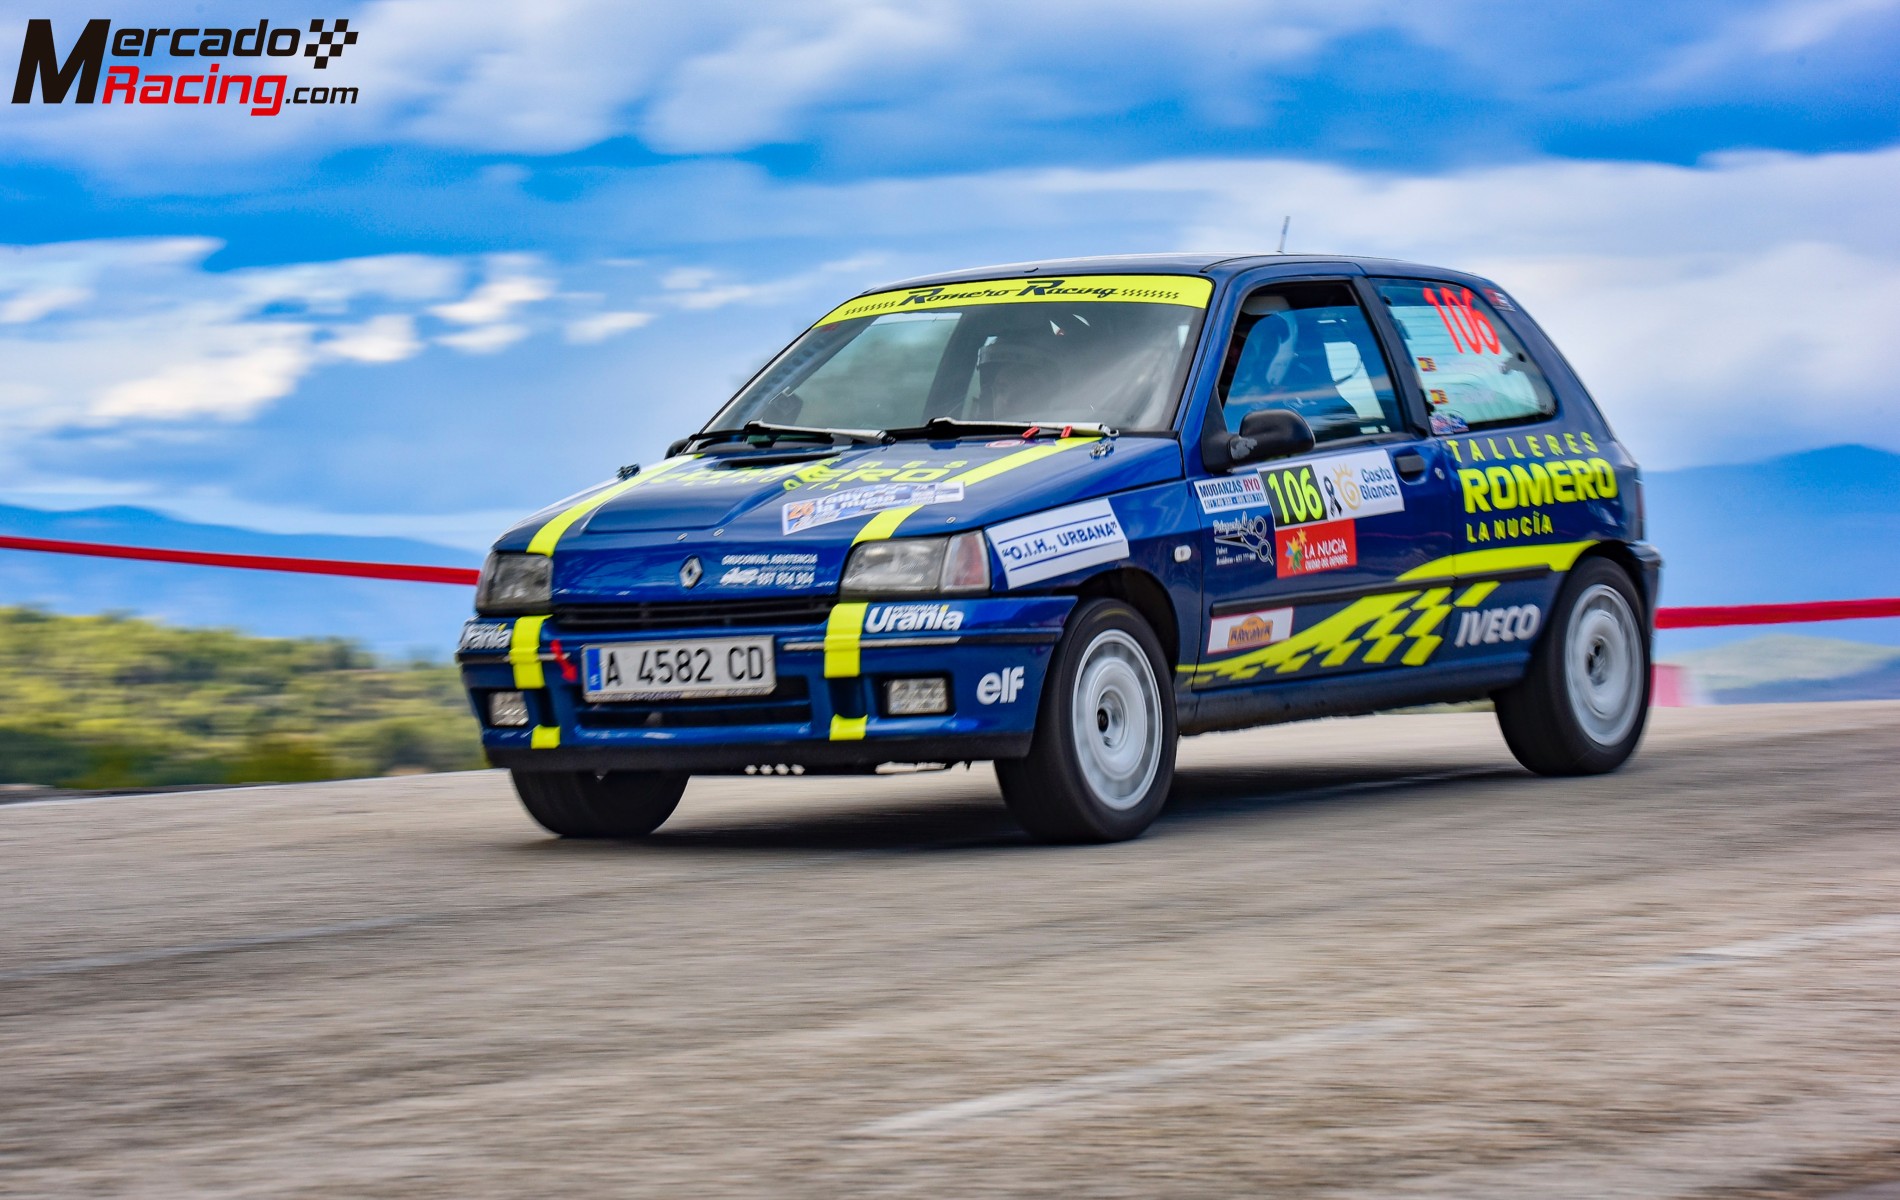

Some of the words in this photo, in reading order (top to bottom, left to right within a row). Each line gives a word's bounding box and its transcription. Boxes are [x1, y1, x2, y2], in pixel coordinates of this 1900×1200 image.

[896, 287, 1016, 306] Romero
[1015, 279, 1119, 298] Racing
[1422, 287, 1501, 355] 106
[1446, 431, 1599, 463] TALLERES
[1198, 480, 1244, 498] MUDANZAS
[1243, 477, 1261, 493] RYO
[1361, 465, 1393, 483] Costa
[1457, 457, 1619, 514] ROMERO
[1267, 467, 1323, 524] 106
[1360, 483, 1398, 500] Blanca
[1466, 522, 1490, 543] LA
[1304, 542, 1316, 559] LA
[865, 604, 964, 633] Urania
[1454, 603, 1541, 648] IVECO
[605, 651, 623, 687] A
[637, 648, 713, 685] 4582
[727, 646, 765, 681] CD
[976, 665, 1025, 705] elf
